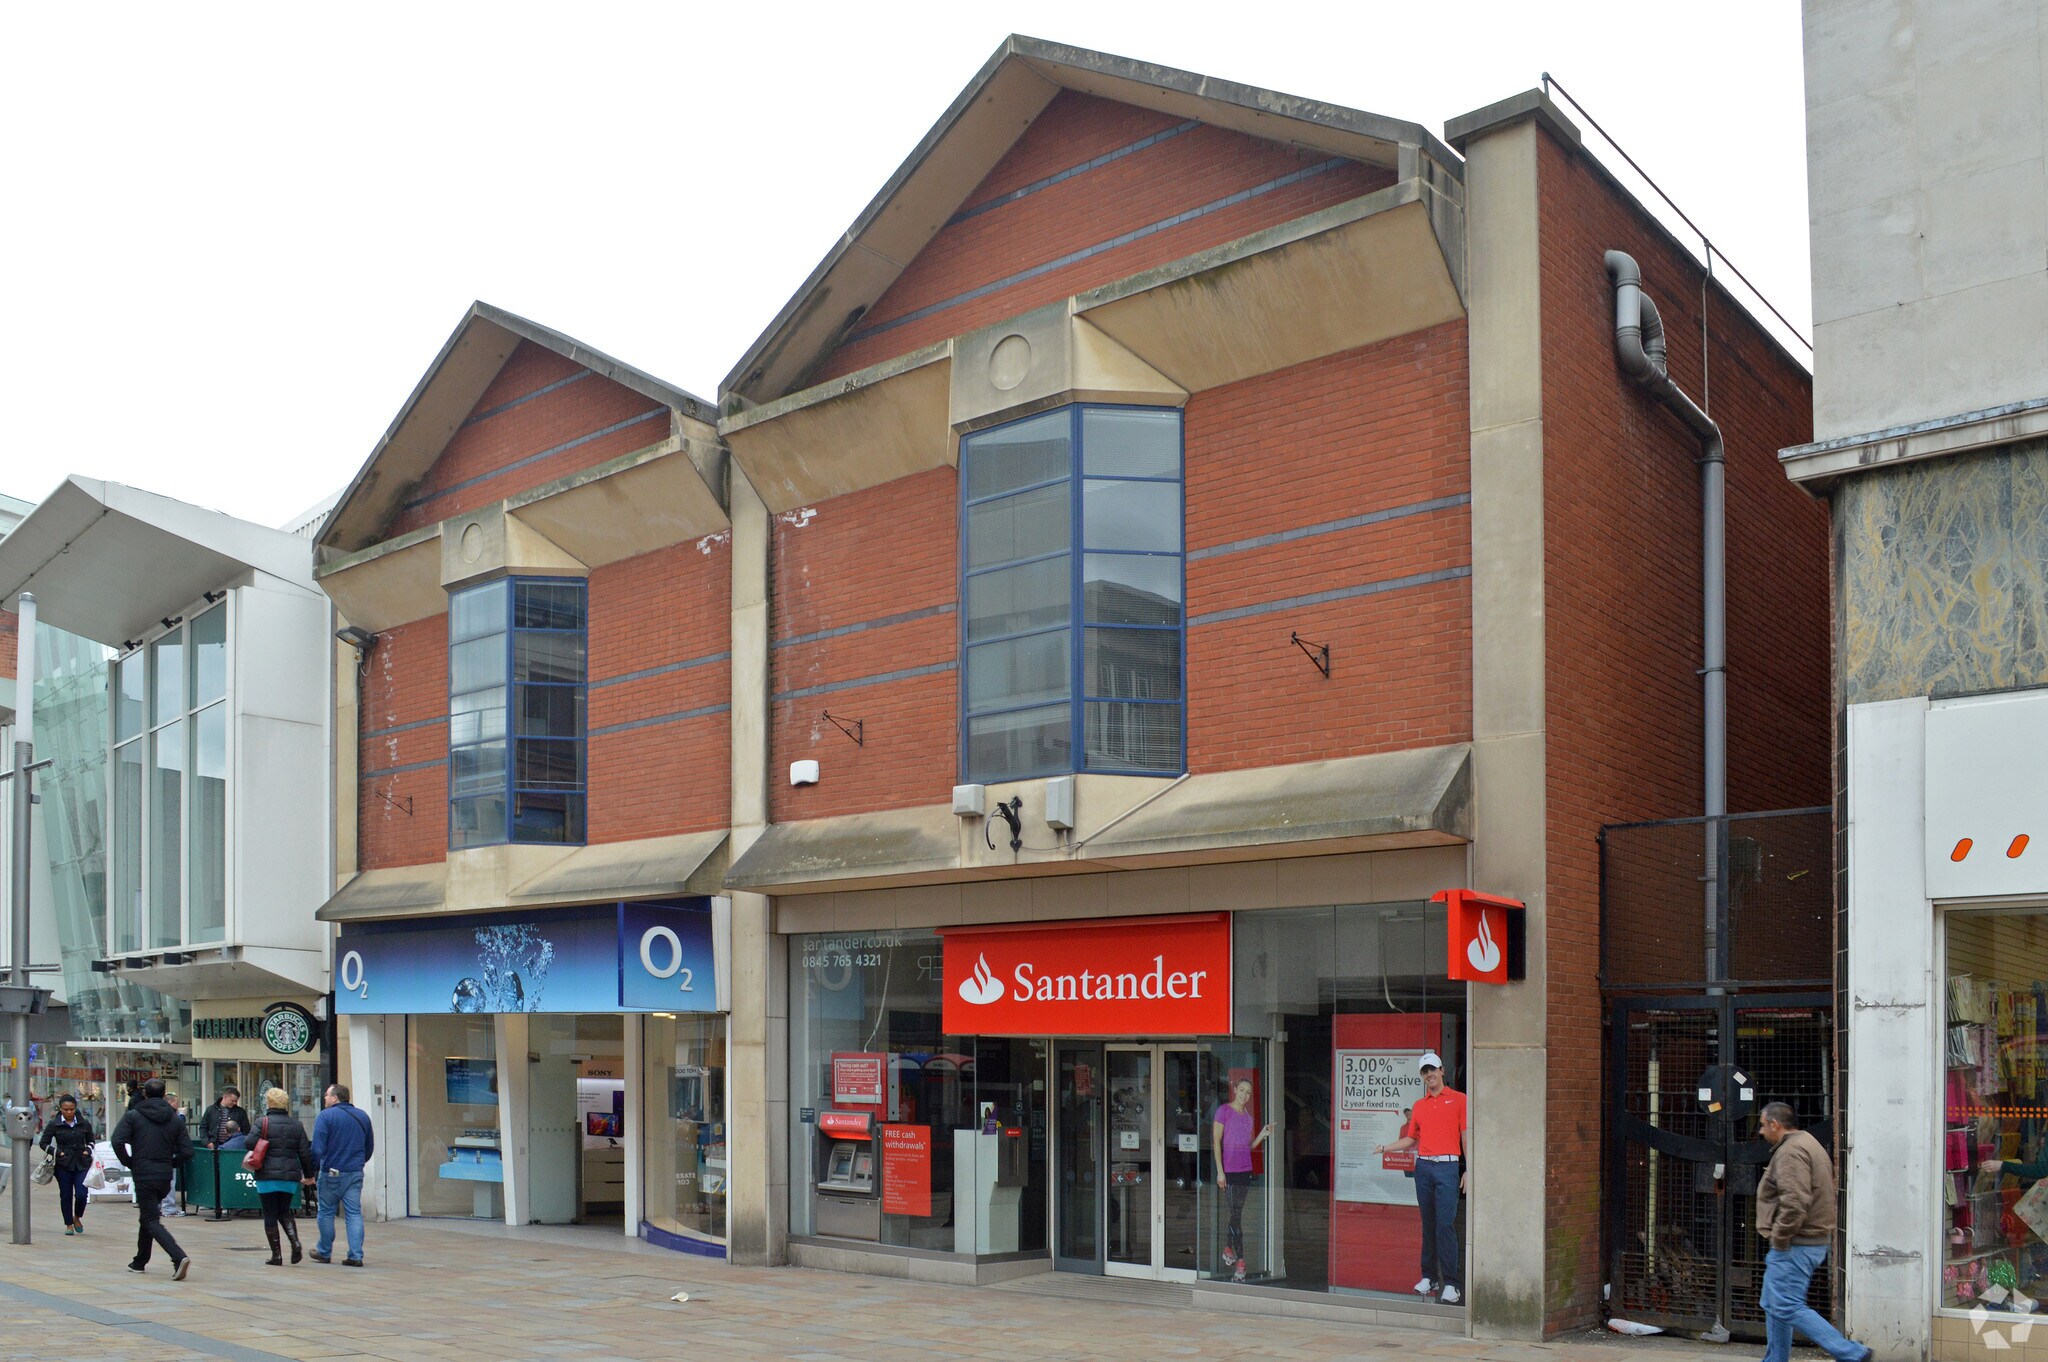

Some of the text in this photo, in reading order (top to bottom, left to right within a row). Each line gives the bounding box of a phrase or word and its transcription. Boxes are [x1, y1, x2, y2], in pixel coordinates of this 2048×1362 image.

[803, 935, 902, 952] santander.co.uk
[639, 925, 694, 993] O2
[803, 954, 881, 968] 0845 765 4321
[341, 950, 369, 999] O2
[1013, 955, 1207, 1002] Santander
[193, 1017, 261, 1039] STARBUCKS
[268, 1013, 307, 1032] STARBUCKS
[272, 1038, 303, 1051] COFFEE
[1345, 1058, 1393, 1073] 3.00%
[1345, 1074, 1422, 1086] 123 Exclusive
[1345, 1086, 1400, 1100] Major ISA
[1366, 1100, 1384, 1108] fixed
[834, 1118, 862, 1126] Santander
[885, 1130, 916, 1139] FREE cash
